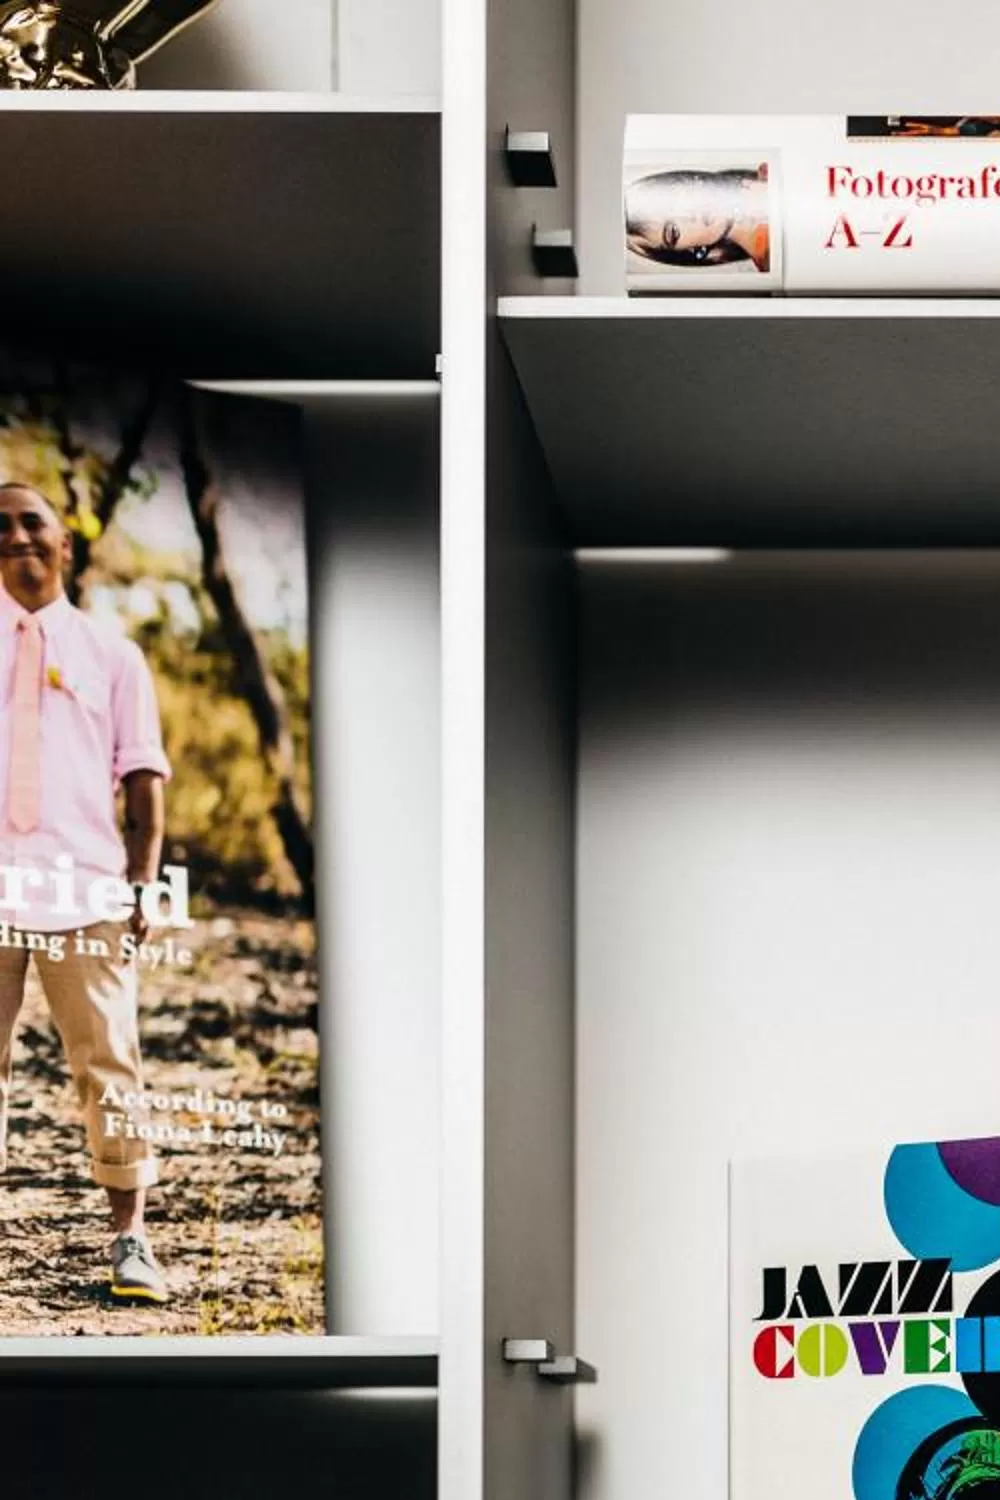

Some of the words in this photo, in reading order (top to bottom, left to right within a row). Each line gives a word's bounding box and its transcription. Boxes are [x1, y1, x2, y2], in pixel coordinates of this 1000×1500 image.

[74, 929, 109, 957] in
[119, 932, 193, 970] Style
[99, 1081, 253, 1125] According
[259, 1098, 288, 1119] to
[104, 1111, 192, 1142] Fiona
[752, 1257, 953, 1321] JAZZ
